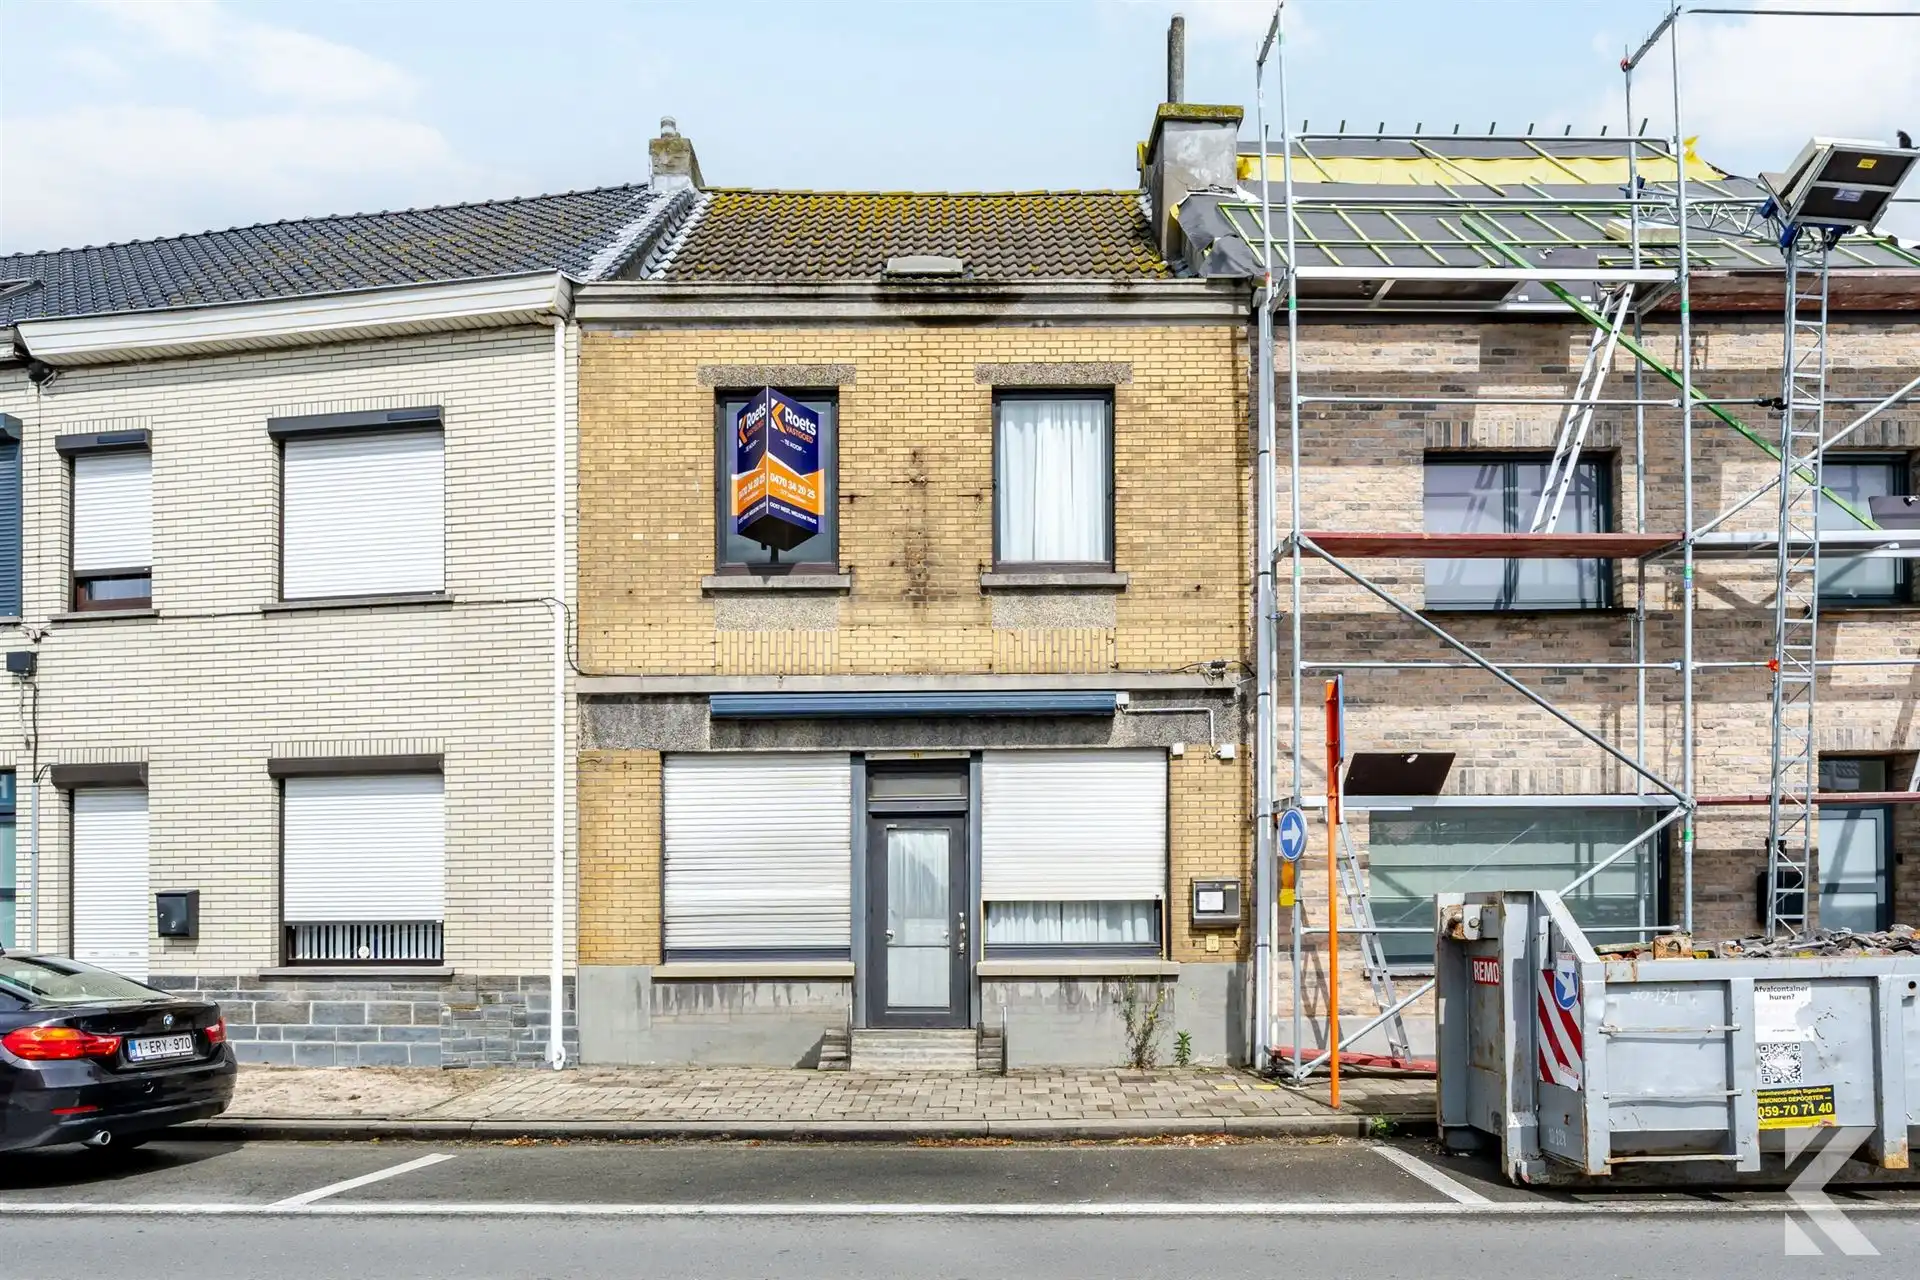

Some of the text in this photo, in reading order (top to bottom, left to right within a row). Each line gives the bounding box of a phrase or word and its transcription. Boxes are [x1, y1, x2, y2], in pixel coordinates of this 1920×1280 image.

[746, 402, 766, 429] Roets
[785, 406, 816, 436] Roets
[785, 424, 814, 444] VASTGOED
[1473, 960, 1500, 984] REMO
[1754, 985, 1809, 993] Afvalcontainer
[1769, 993, 1796, 1001] huren?
[1758, 1102, 1833, 1117] 059-70 71 40
